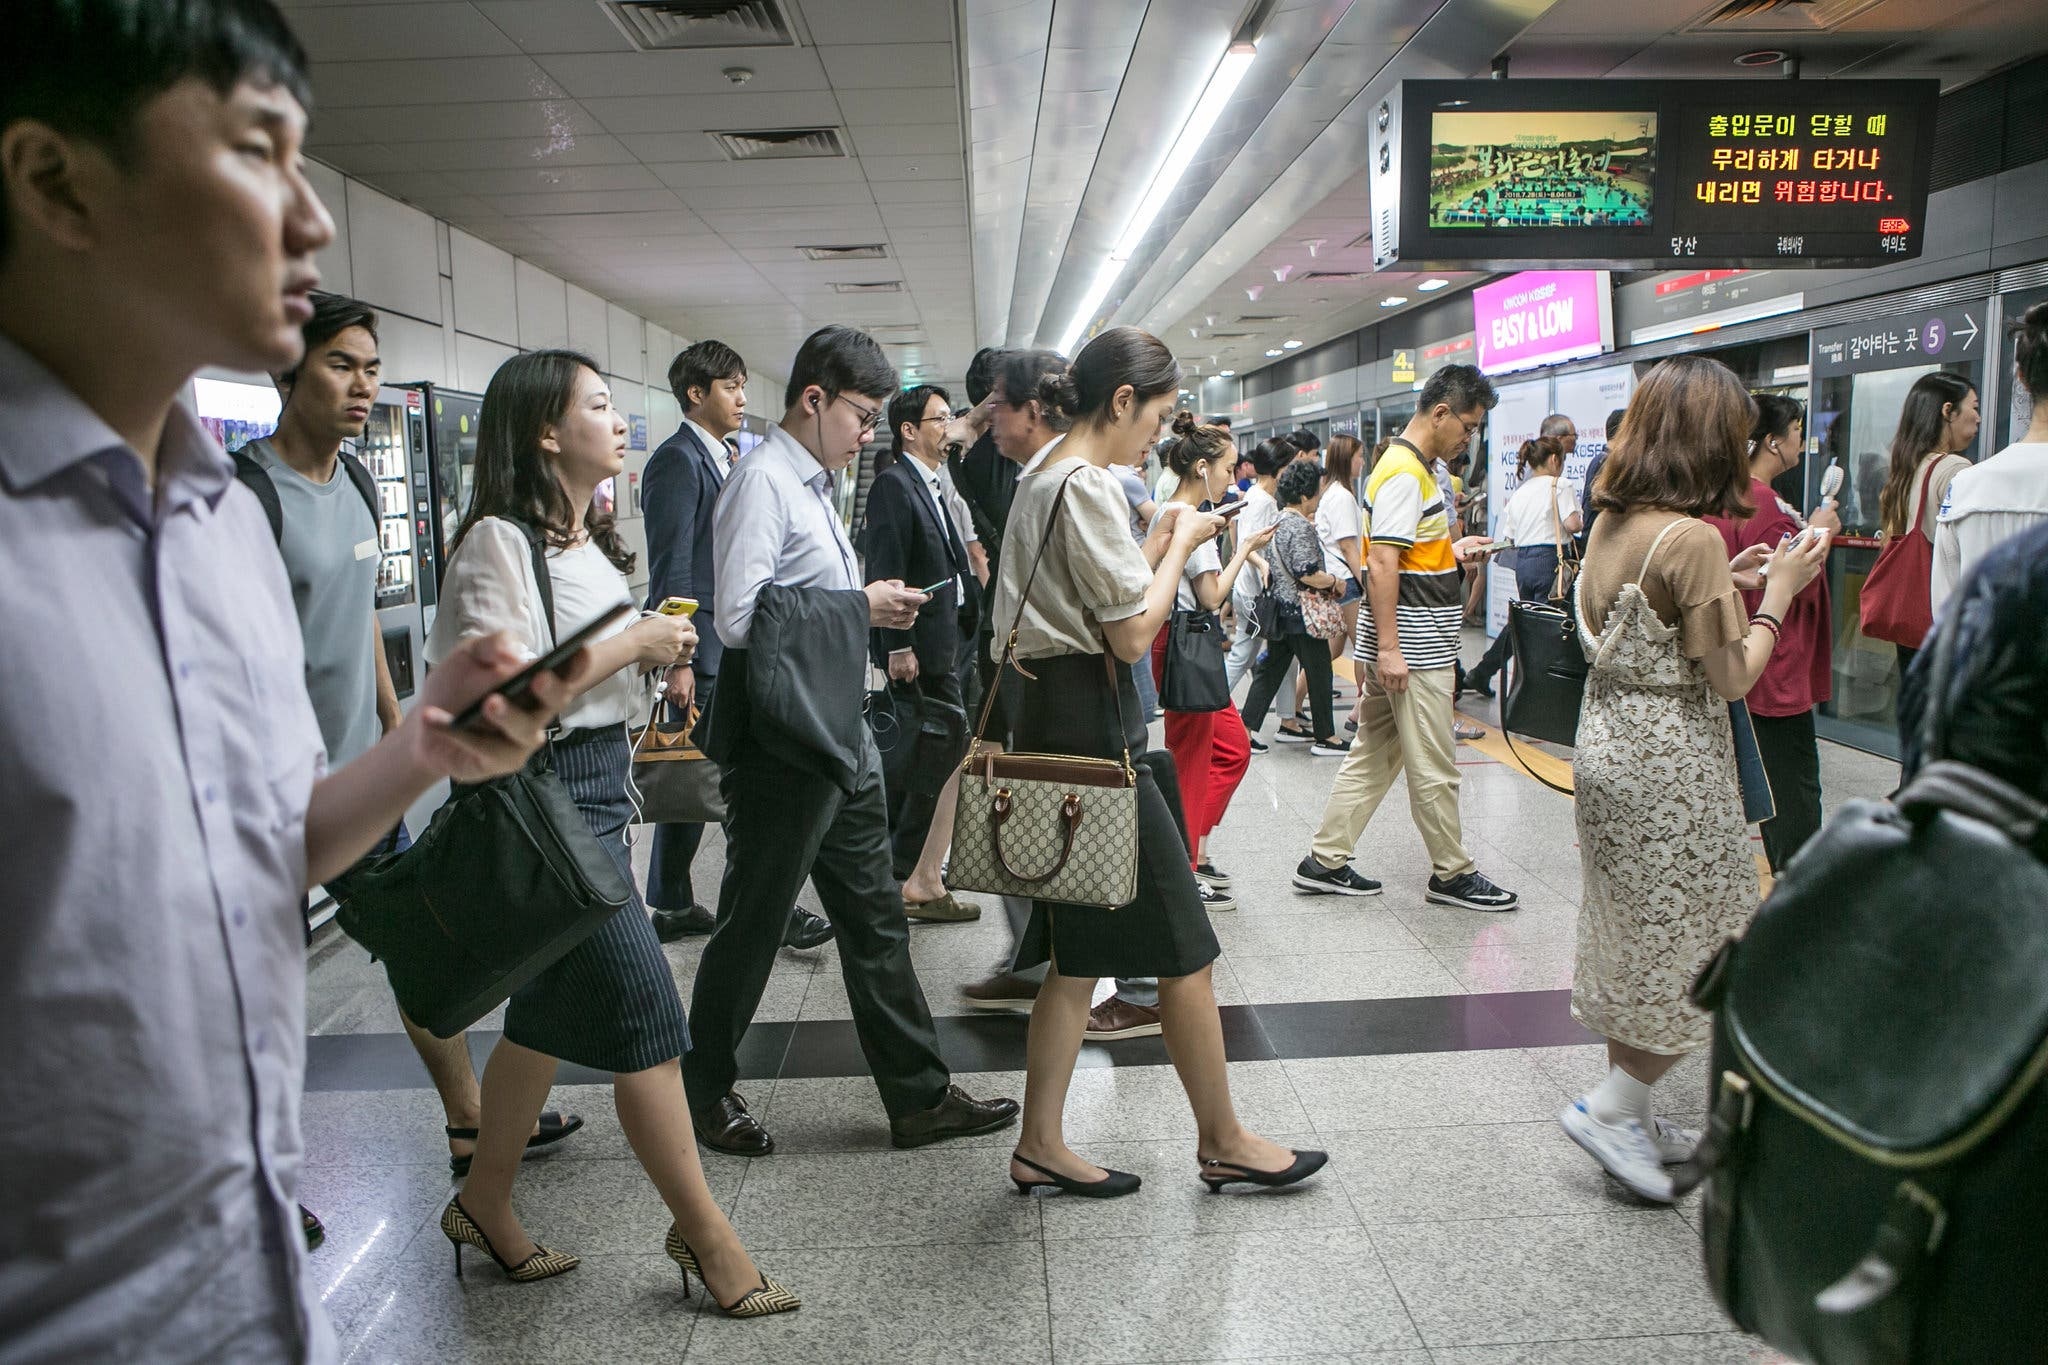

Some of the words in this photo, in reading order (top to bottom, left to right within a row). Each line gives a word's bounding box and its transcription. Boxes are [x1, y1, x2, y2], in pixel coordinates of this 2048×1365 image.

[1708, 114, 1795, 137] 출입문이
[1810, 114, 1853, 136] 닫힐
[1866, 114, 1887, 136] 때
[1712, 148, 1799, 171] 무리하게
[1813, 148, 1881, 170] 타거나
[1696, 181, 1761, 203] 내리면
[1774, 180, 1894, 203] 위험합니다.
[1671, 236, 1698, 256] 당산
[1881, 235, 1907, 253] 여의도
[1491, 311, 1526, 350] EASY
[1527, 311, 1539, 341] &
[1539, 297, 1574, 338] LOW
[1818, 342, 1843, 354] Transfer
[1850, 331, 1900, 360] 갈아타는
[1904, 328, 1919, 352] 곳
[1928, 325, 1940, 349] 5
[1501, 451, 1520, 466] KOS
[1504, 472, 1518, 491] 20
